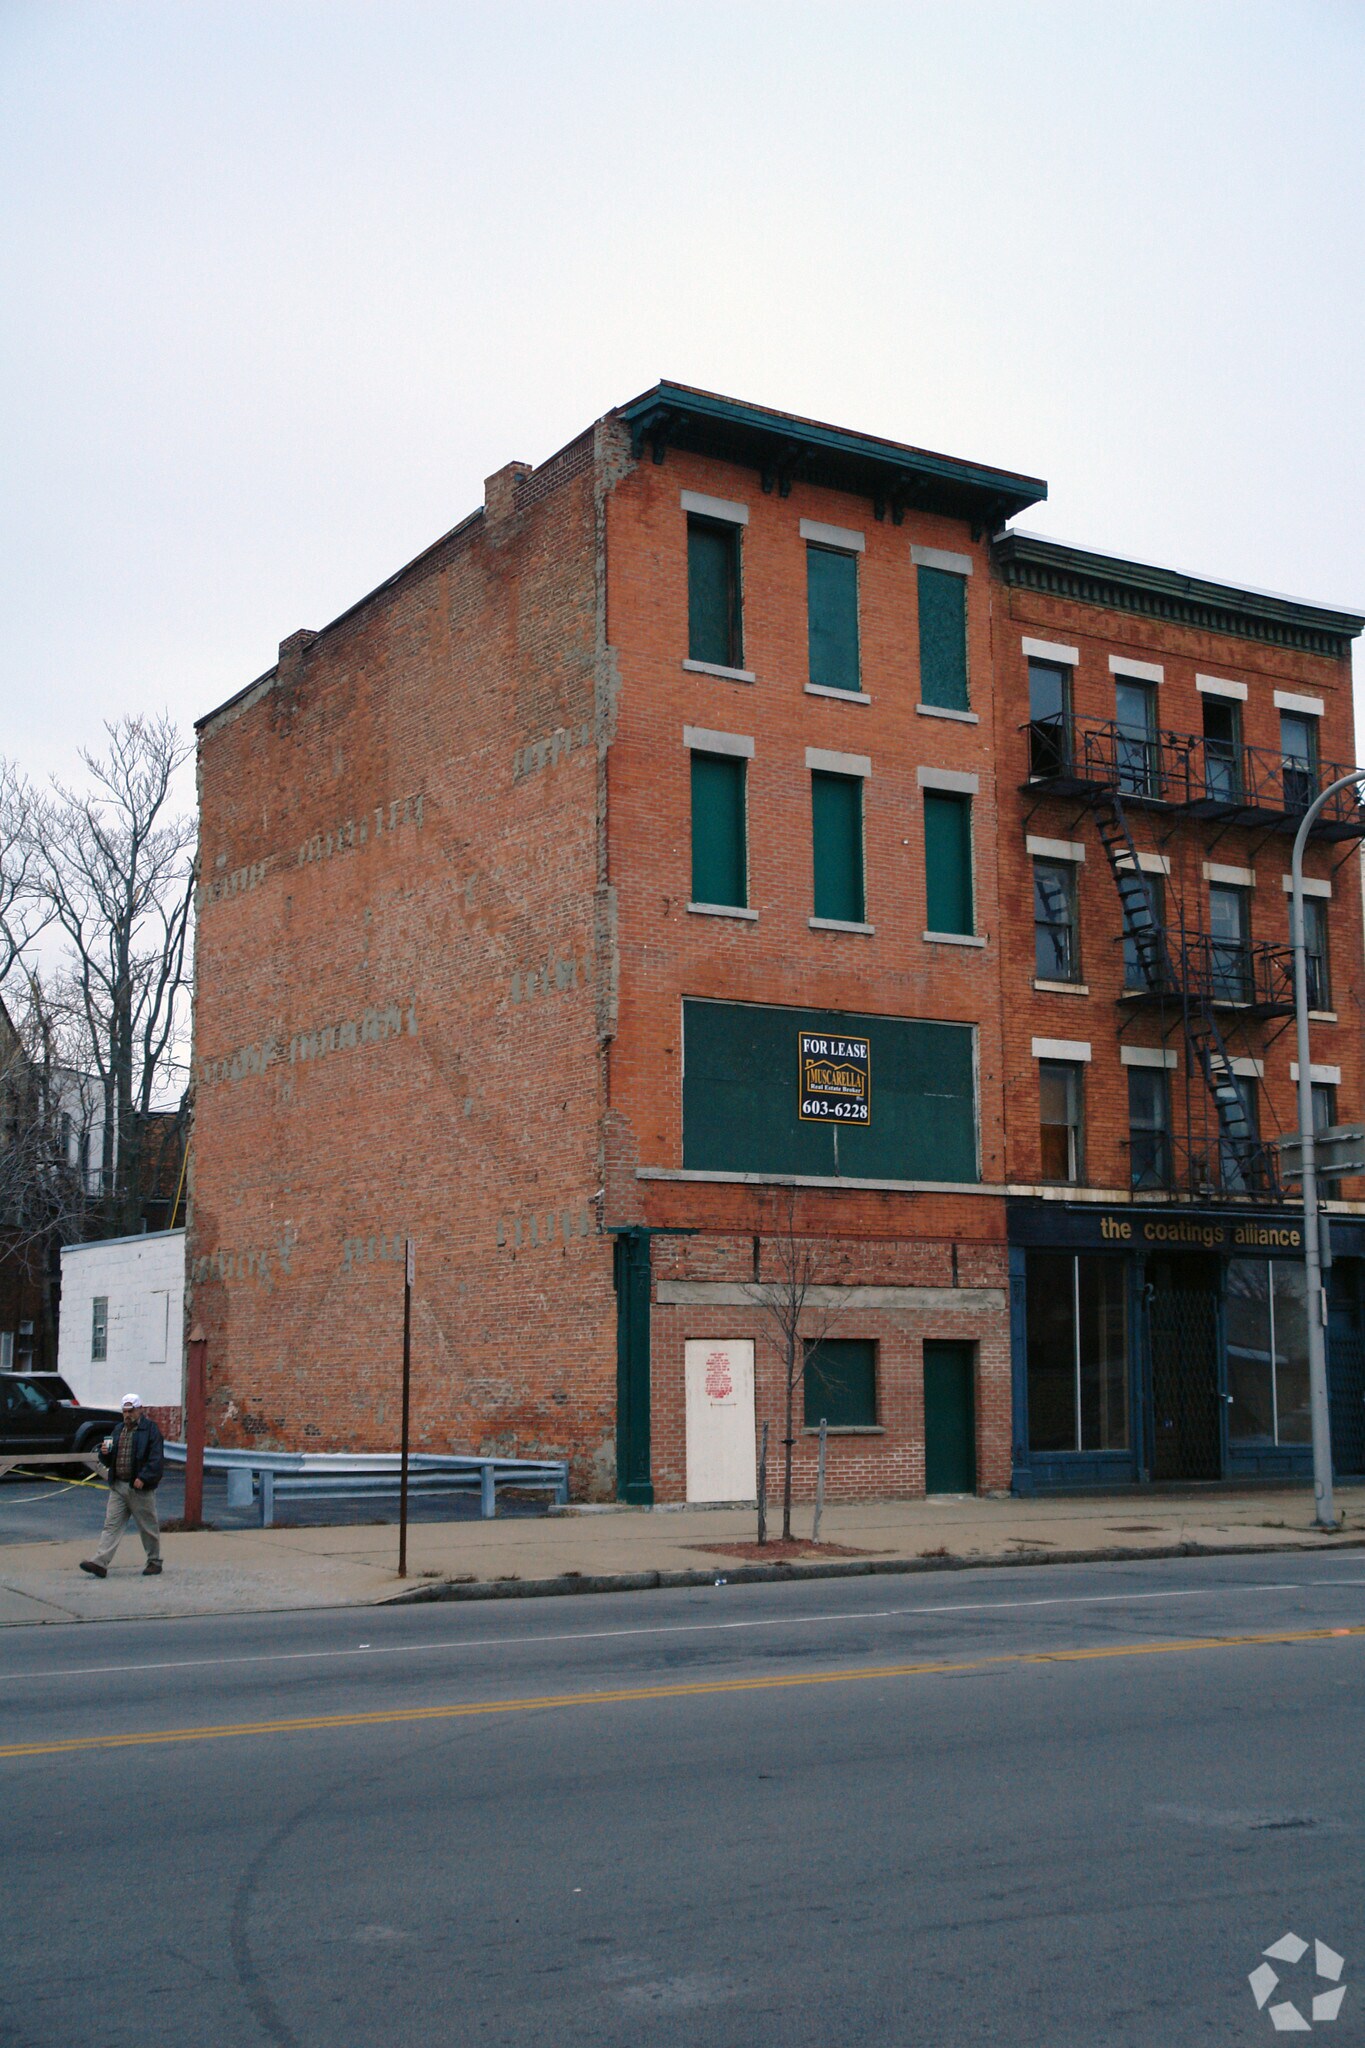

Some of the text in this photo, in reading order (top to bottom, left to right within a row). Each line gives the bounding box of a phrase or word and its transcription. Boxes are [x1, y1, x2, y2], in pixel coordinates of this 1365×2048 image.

[803, 1039, 867, 1058] FOR LEASE
[810, 1069, 861, 1087] MUSCARELLA
[802, 1100, 868, 1119] 603-6228
[1100, 1217, 1301, 1247] the coatings alliance
